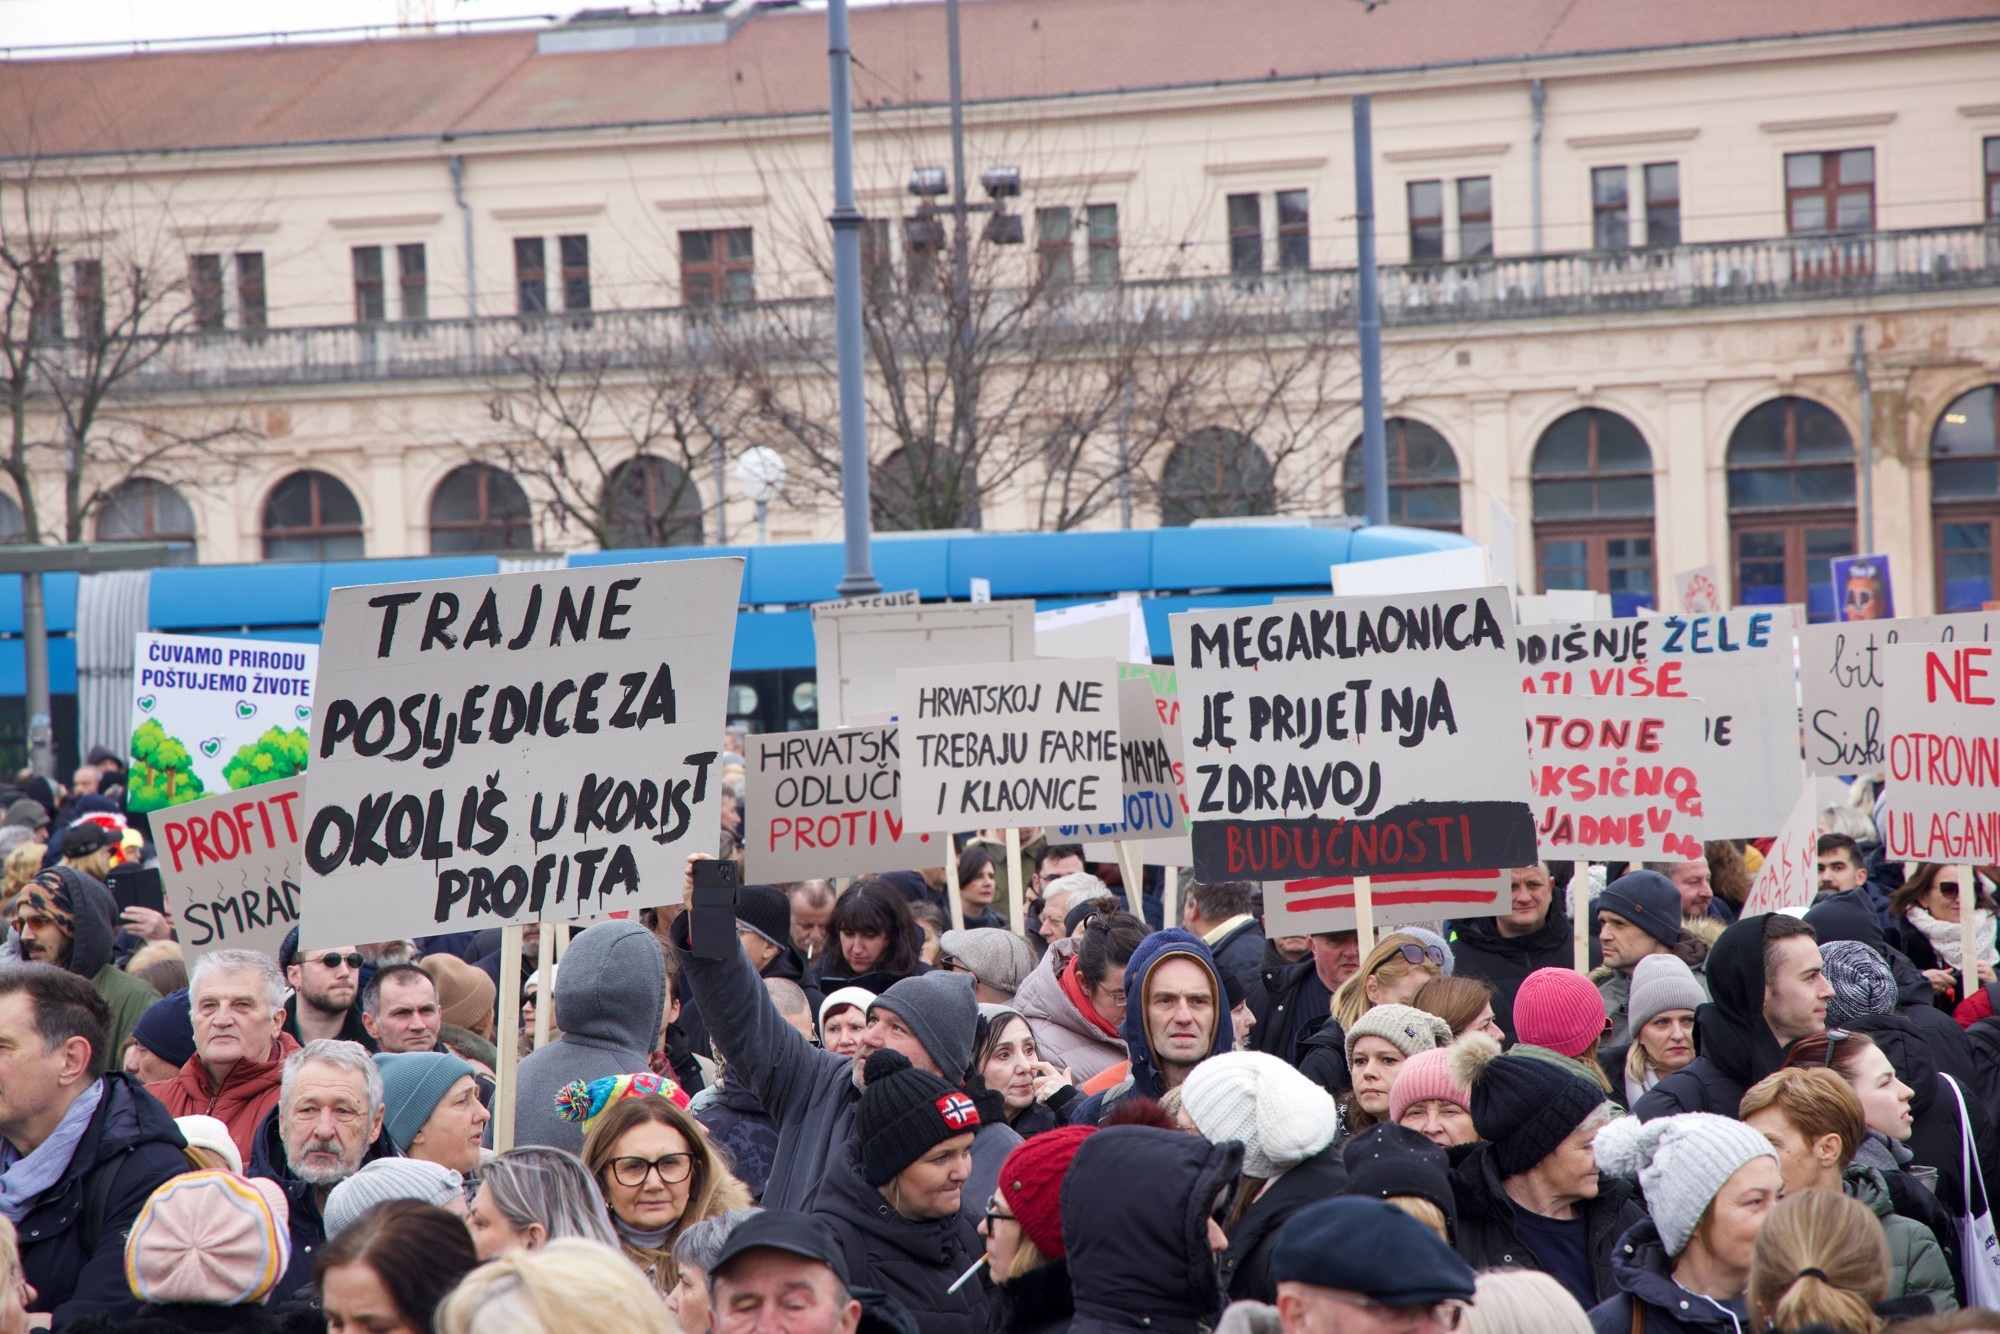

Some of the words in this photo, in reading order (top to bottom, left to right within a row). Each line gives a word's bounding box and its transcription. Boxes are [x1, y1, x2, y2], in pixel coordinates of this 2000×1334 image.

[368, 577, 641, 658] TRAJNE
[1190, 598, 1506, 670] MEGAKLAONICA
[1661, 613, 1773, 653] ŽELE
[141, 666, 247, 693] POŠTUJEMO
[252, 672, 310, 697] ŽIVOTE
[148, 640, 223, 666] ČUVAMO
[229, 648, 305, 671] PRIRODU
[1589, 659, 1688, 698] VIŠE
[1926, 647, 1996, 706] NE
[320, 672, 609, 769] POSLJEDICE
[609, 662, 677, 730] ZA
[918, 683, 1041, 719] HRVATSKOJ
[1056, 680, 1104, 714] NE
[1193, 691, 1237, 749] JE
[1249, 677, 1458, 750] PRIJETNJA
[916, 731, 1028, 768] TREBAJU
[1039, 729, 1118, 764] FARME
[1526, 715, 1665, 753] TONE
[304, 769, 509, 876] OKOLIŠ
[529, 791, 568, 845] U
[574, 751, 719, 845] KORIST
[937, 782, 947, 815] I
[960, 775, 1100, 814] KLAONICE
[1196, 760, 1381, 816] ZDRAVOJ
[1529, 756, 1703, 818] KSIČNOG
[164, 791, 299, 873] PROFIT
[769, 809, 930, 853] PROTIV
[1889, 809, 2000, 867] ULAGANJ
[184, 879, 301, 945] SMRAD
[434, 843, 640, 924] PROFITA
